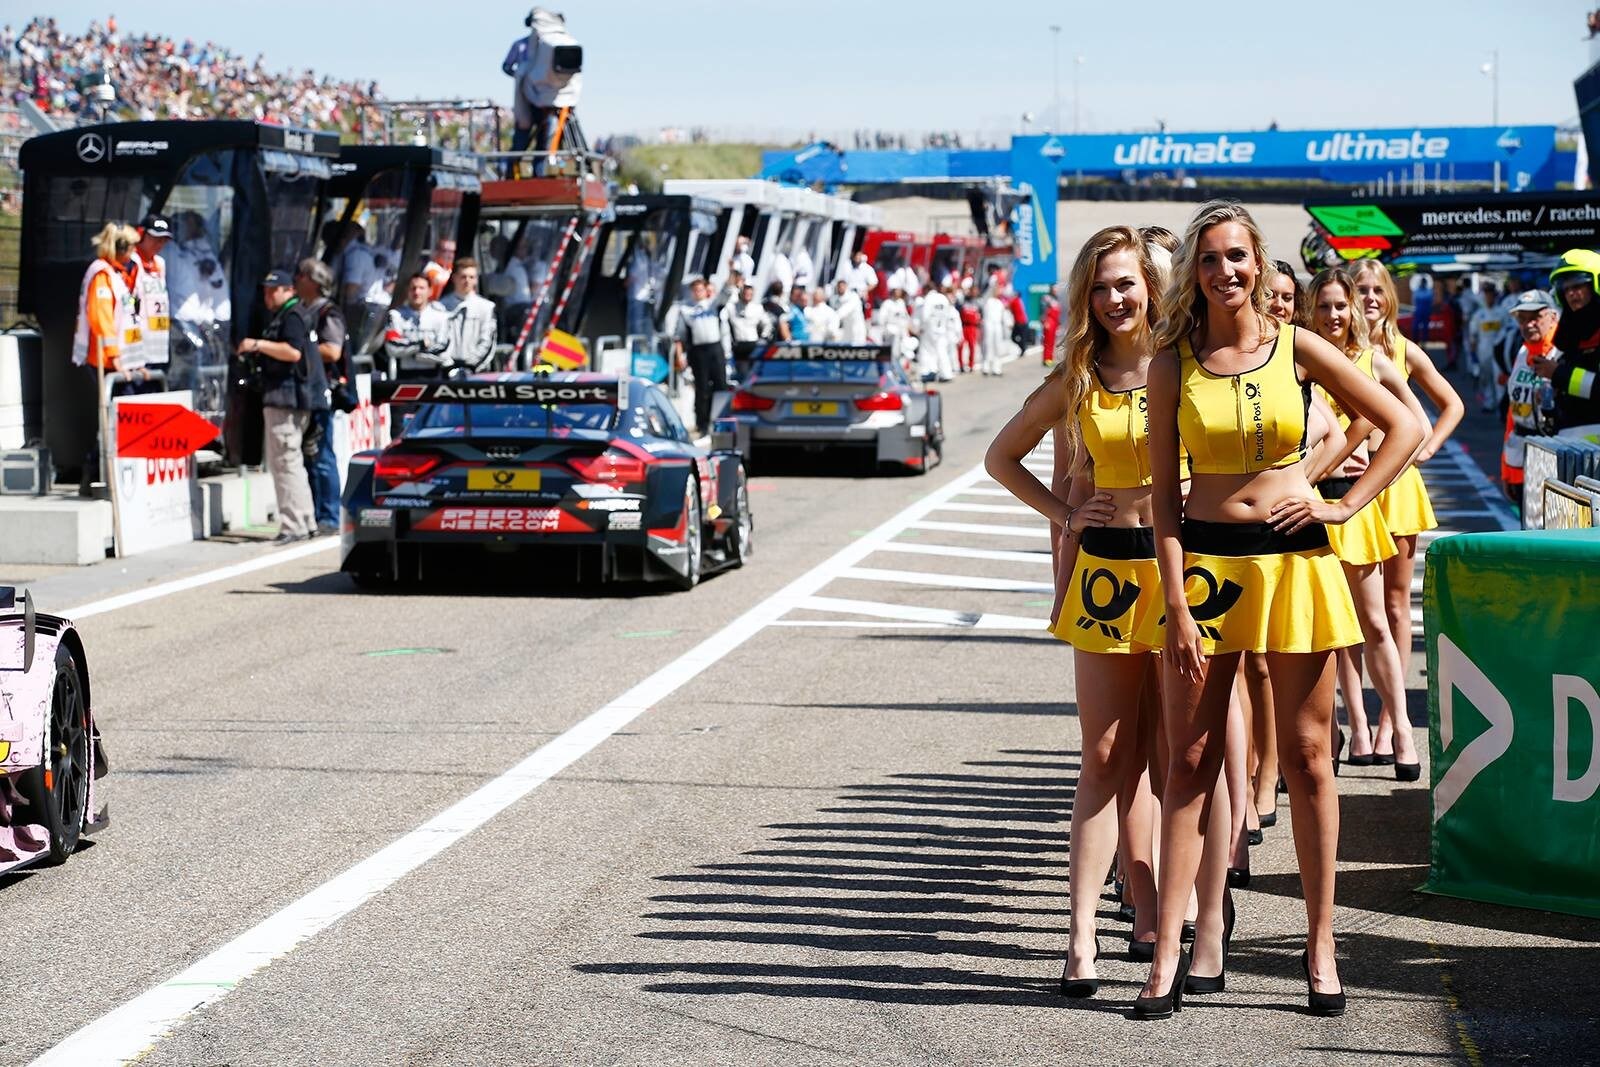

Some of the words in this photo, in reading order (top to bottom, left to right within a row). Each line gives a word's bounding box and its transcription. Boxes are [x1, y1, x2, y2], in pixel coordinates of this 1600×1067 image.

[1113, 134, 1256, 166] ultimate
[1306, 130, 1449, 162] ultimate
[1422, 206, 1533, 226] mercedes.me
[807, 346, 881, 360] Power
[433, 385, 506, 399] Audi
[515, 385, 608, 402] Sport
[117, 411, 153, 425] WIC
[1253, 401, 1262, 422] Post
[149, 437, 189, 450] JUN
[1254, 422, 1264, 462] Deutsche
[443, 508, 523, 520] SPEED
[441, 519, 559, 531] WEEK.COM
